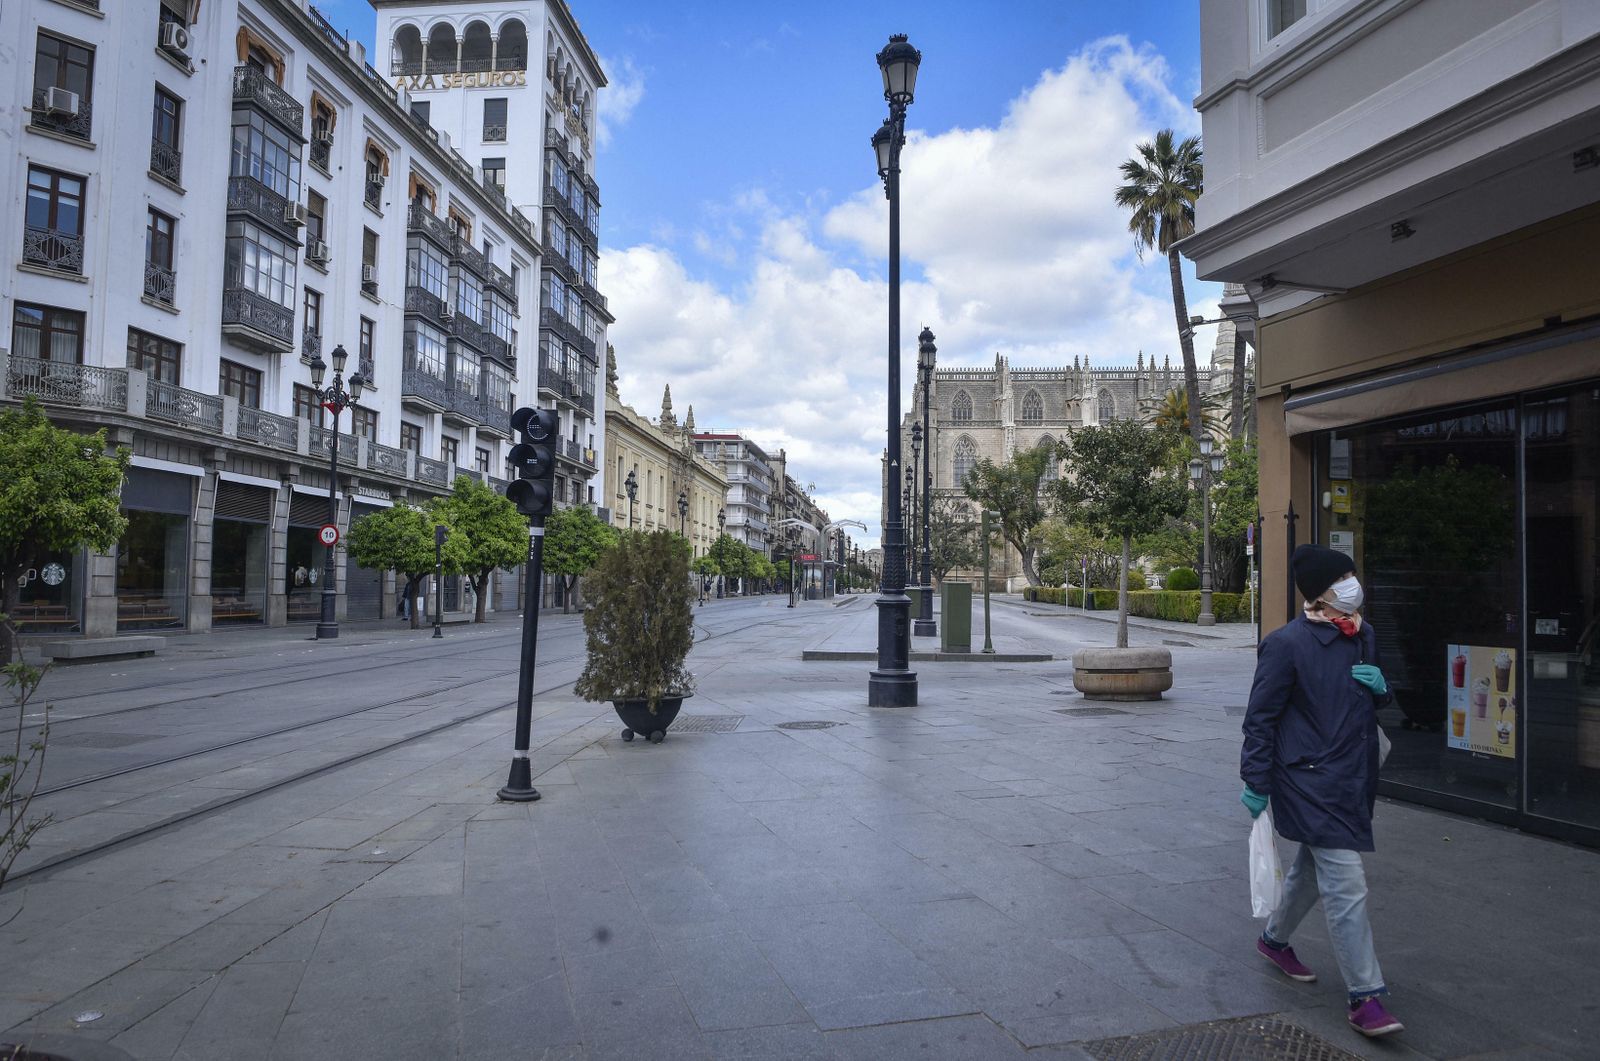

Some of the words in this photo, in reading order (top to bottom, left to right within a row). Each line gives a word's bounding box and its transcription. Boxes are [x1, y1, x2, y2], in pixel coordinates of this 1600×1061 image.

[395, 74, 436, 91] AXA
[442, 70, 526, 88] SEGUROS
[359, 487, 390, 499] STARBUCKS
[1481, 744, 1503, 753] DRINKS
